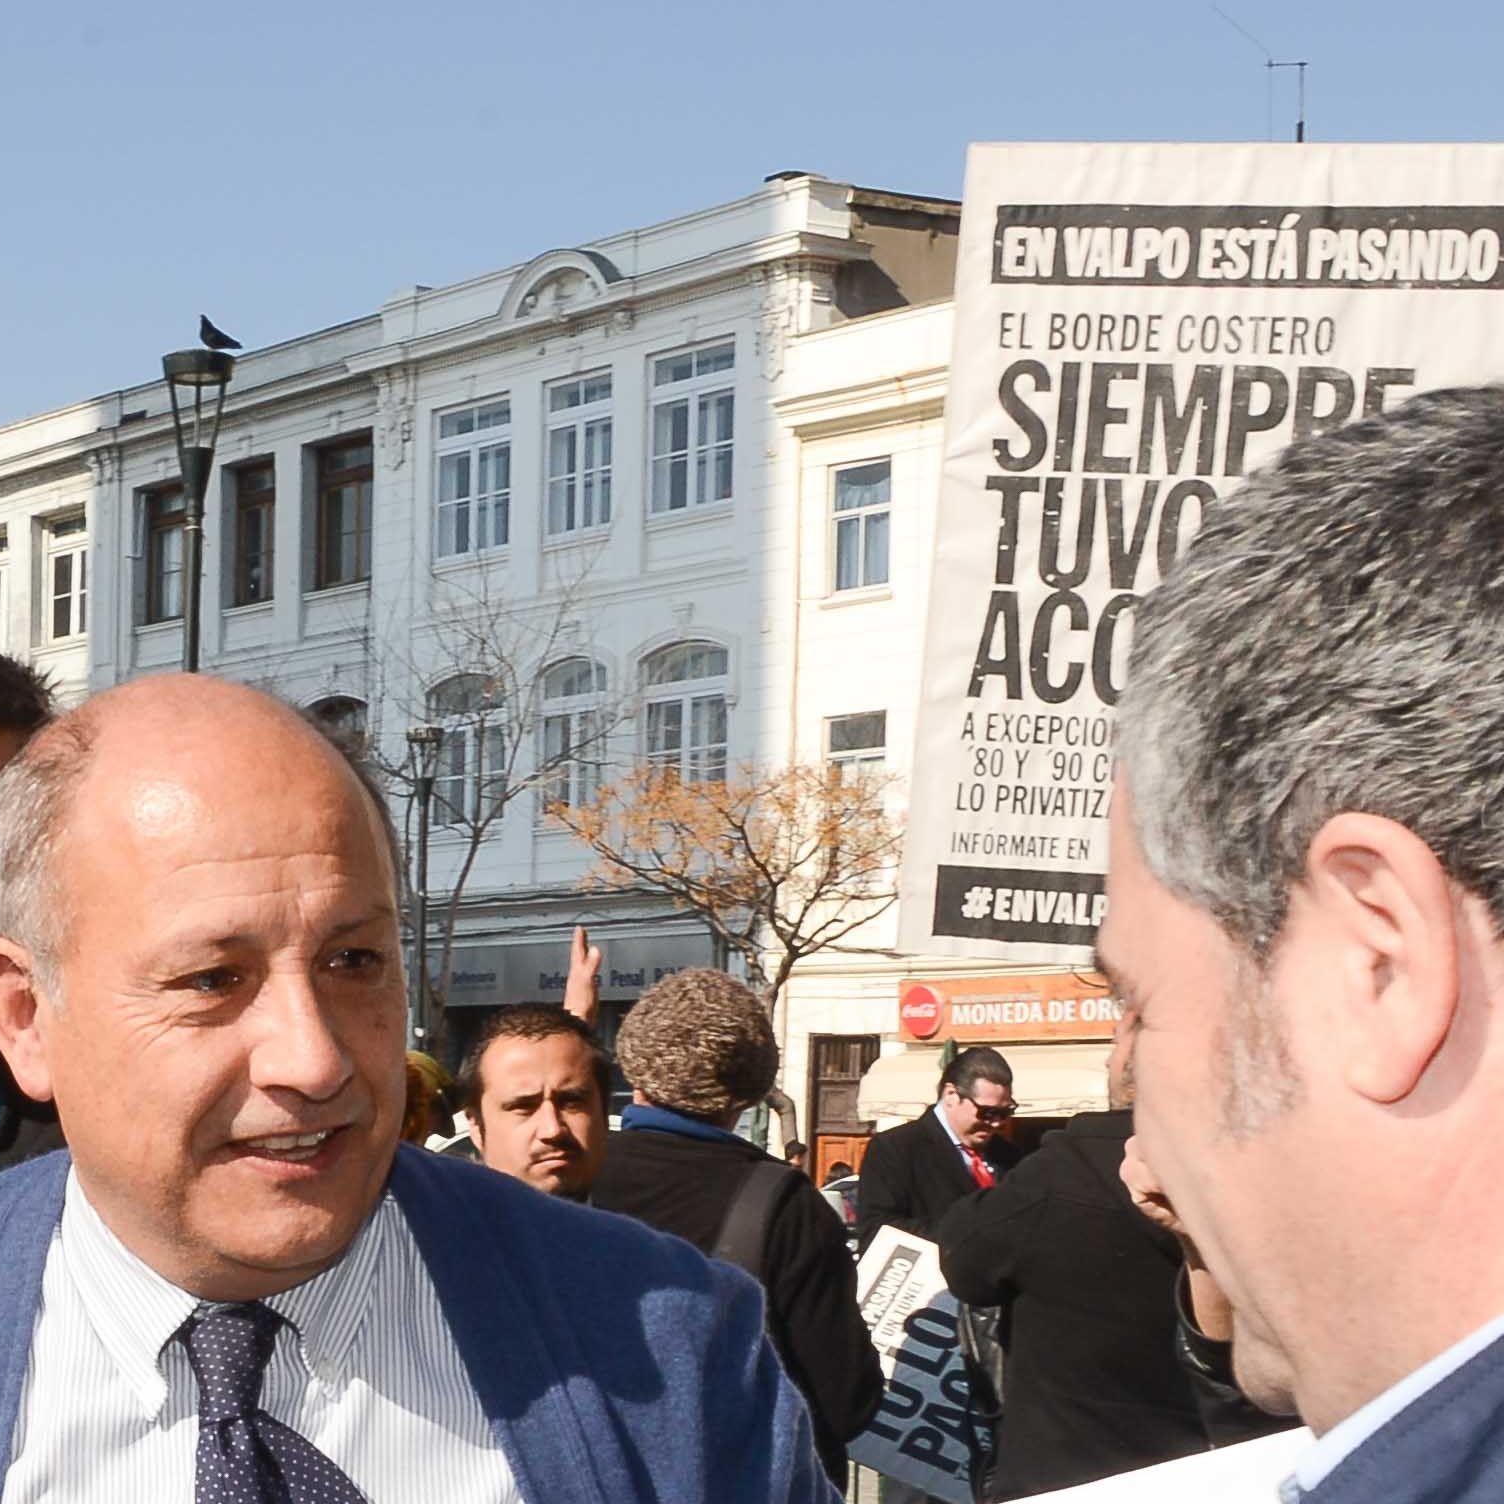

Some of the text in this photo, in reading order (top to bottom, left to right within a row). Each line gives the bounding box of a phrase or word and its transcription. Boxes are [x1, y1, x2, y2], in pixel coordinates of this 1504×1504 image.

[1000, 213, 1501, 284] EN VALPO ESTÁ PASANDO
[998, 311, 1336, 357] EL BORDE COSTERO
[966, 590, 1135, 705] ACC
[960, 711, 976, 741] A
[1015, 749, 1030, 780] Y
[955, 781, 1112, 820] LO PRIVATIZ
[951, 826, 1091, 861] INFÓRMATE EN
[951, 1001, 1044, 1026] MONEDA
[1048, 999, 1078, 1023] DE
[895, 1307, 962, 1377] LO
